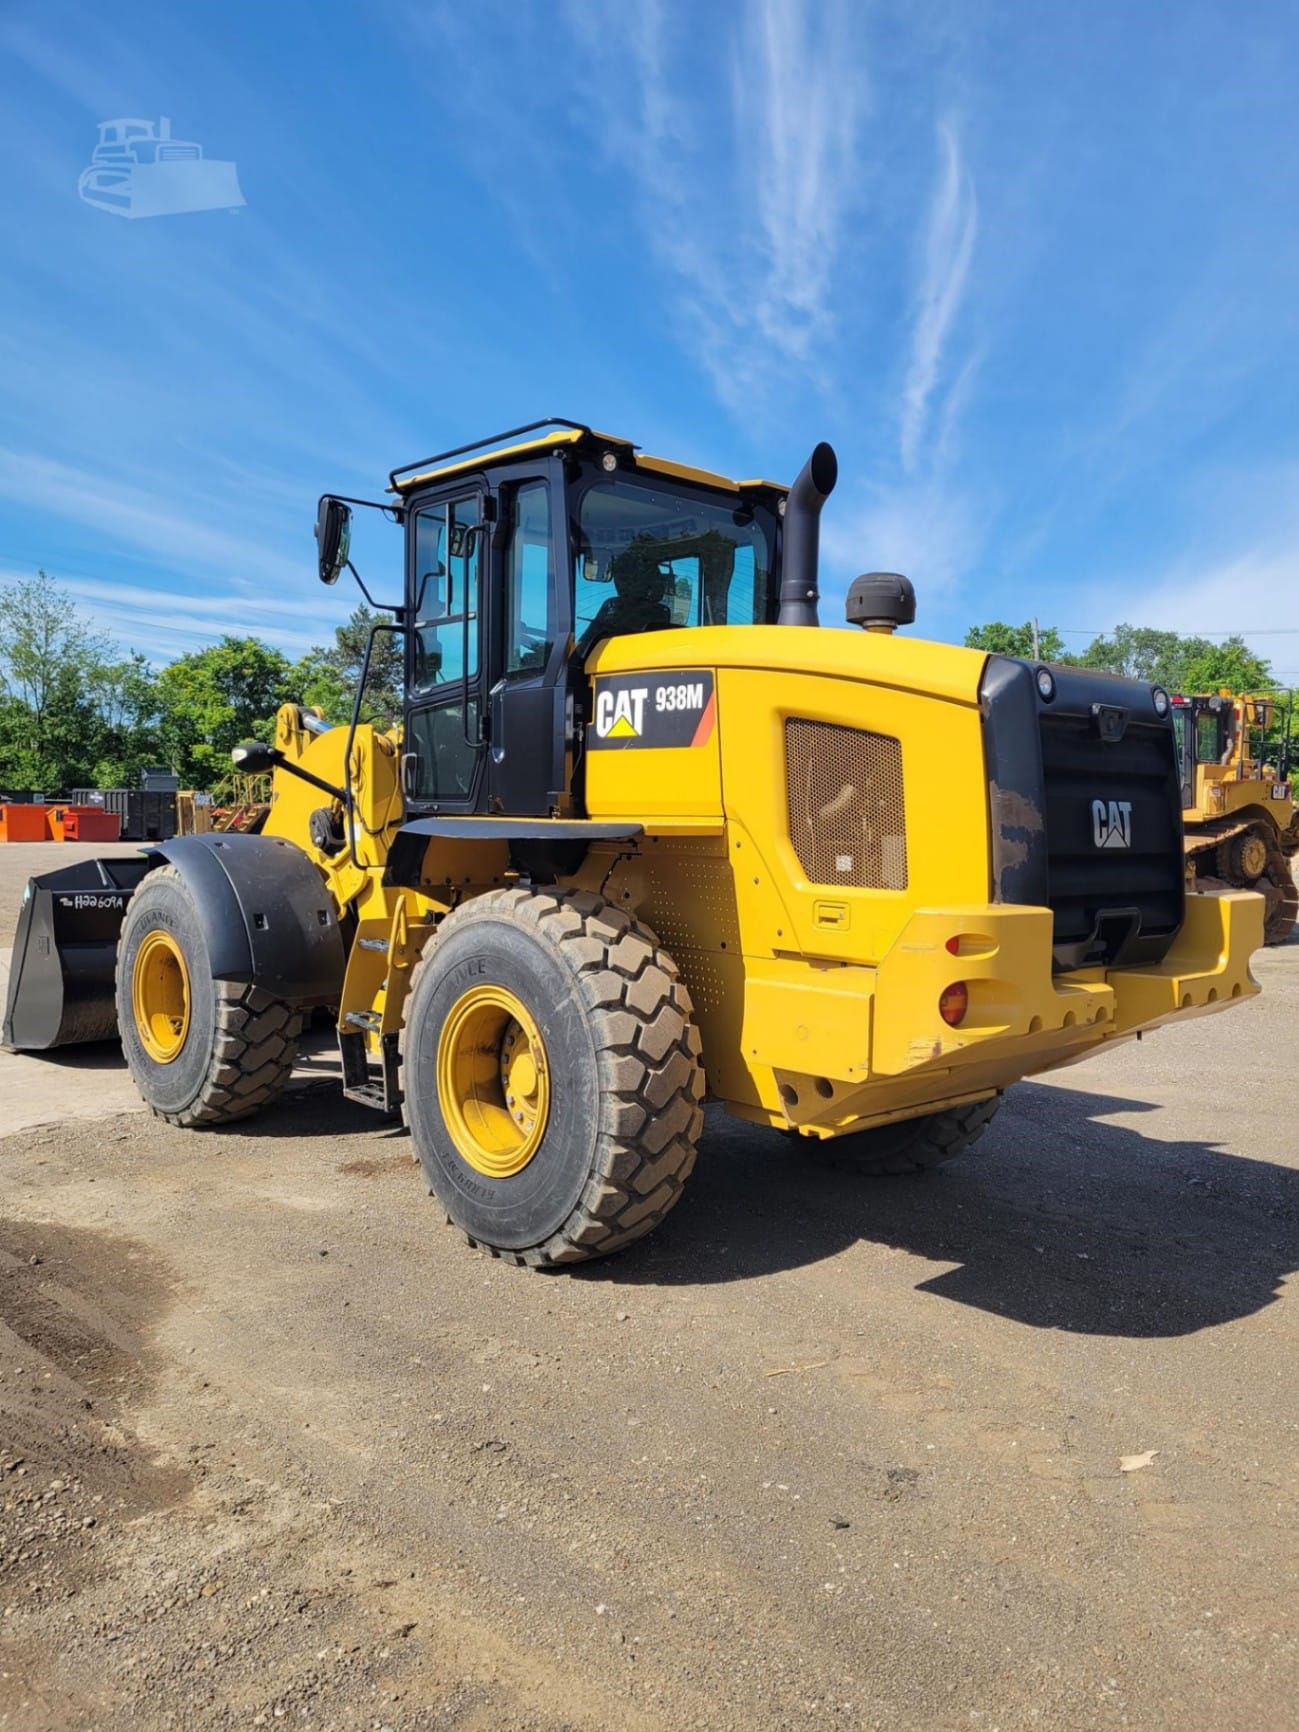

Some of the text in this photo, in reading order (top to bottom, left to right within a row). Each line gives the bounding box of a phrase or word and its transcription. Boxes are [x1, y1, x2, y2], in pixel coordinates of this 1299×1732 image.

[597, 684, 703, 738] CAT 938M
[1273, 784, 1286, 799] CAT
[1092, 799, 1132, 848] CAT
